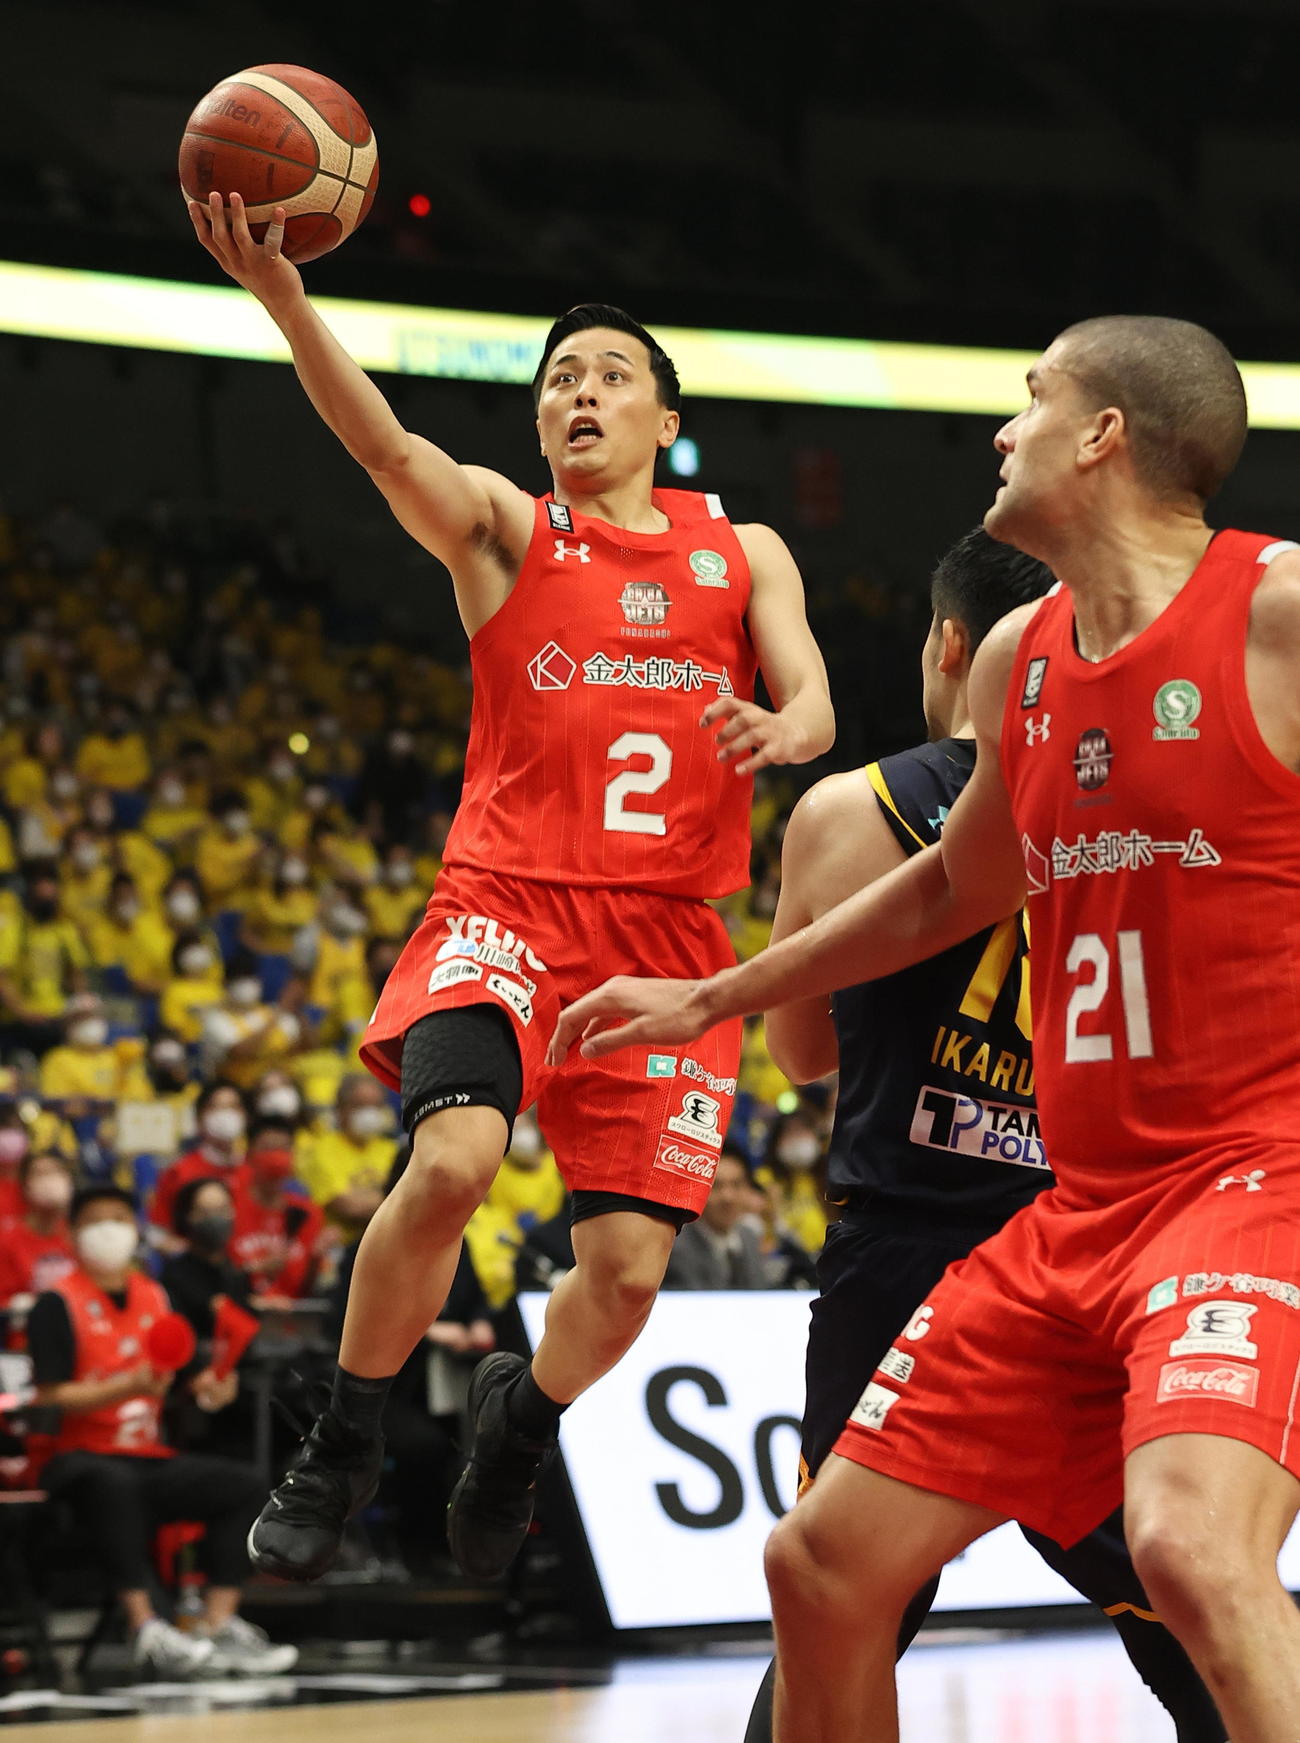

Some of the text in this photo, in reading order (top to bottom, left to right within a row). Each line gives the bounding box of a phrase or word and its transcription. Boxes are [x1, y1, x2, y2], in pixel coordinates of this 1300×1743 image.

[582, 652, 734, 696] 金太郎ホーム
[603, 731, 673, 836] 2
[1051, 829, 1222, 879] 金太郎ホーム
[1065, 930, 1154, 1063] 21
